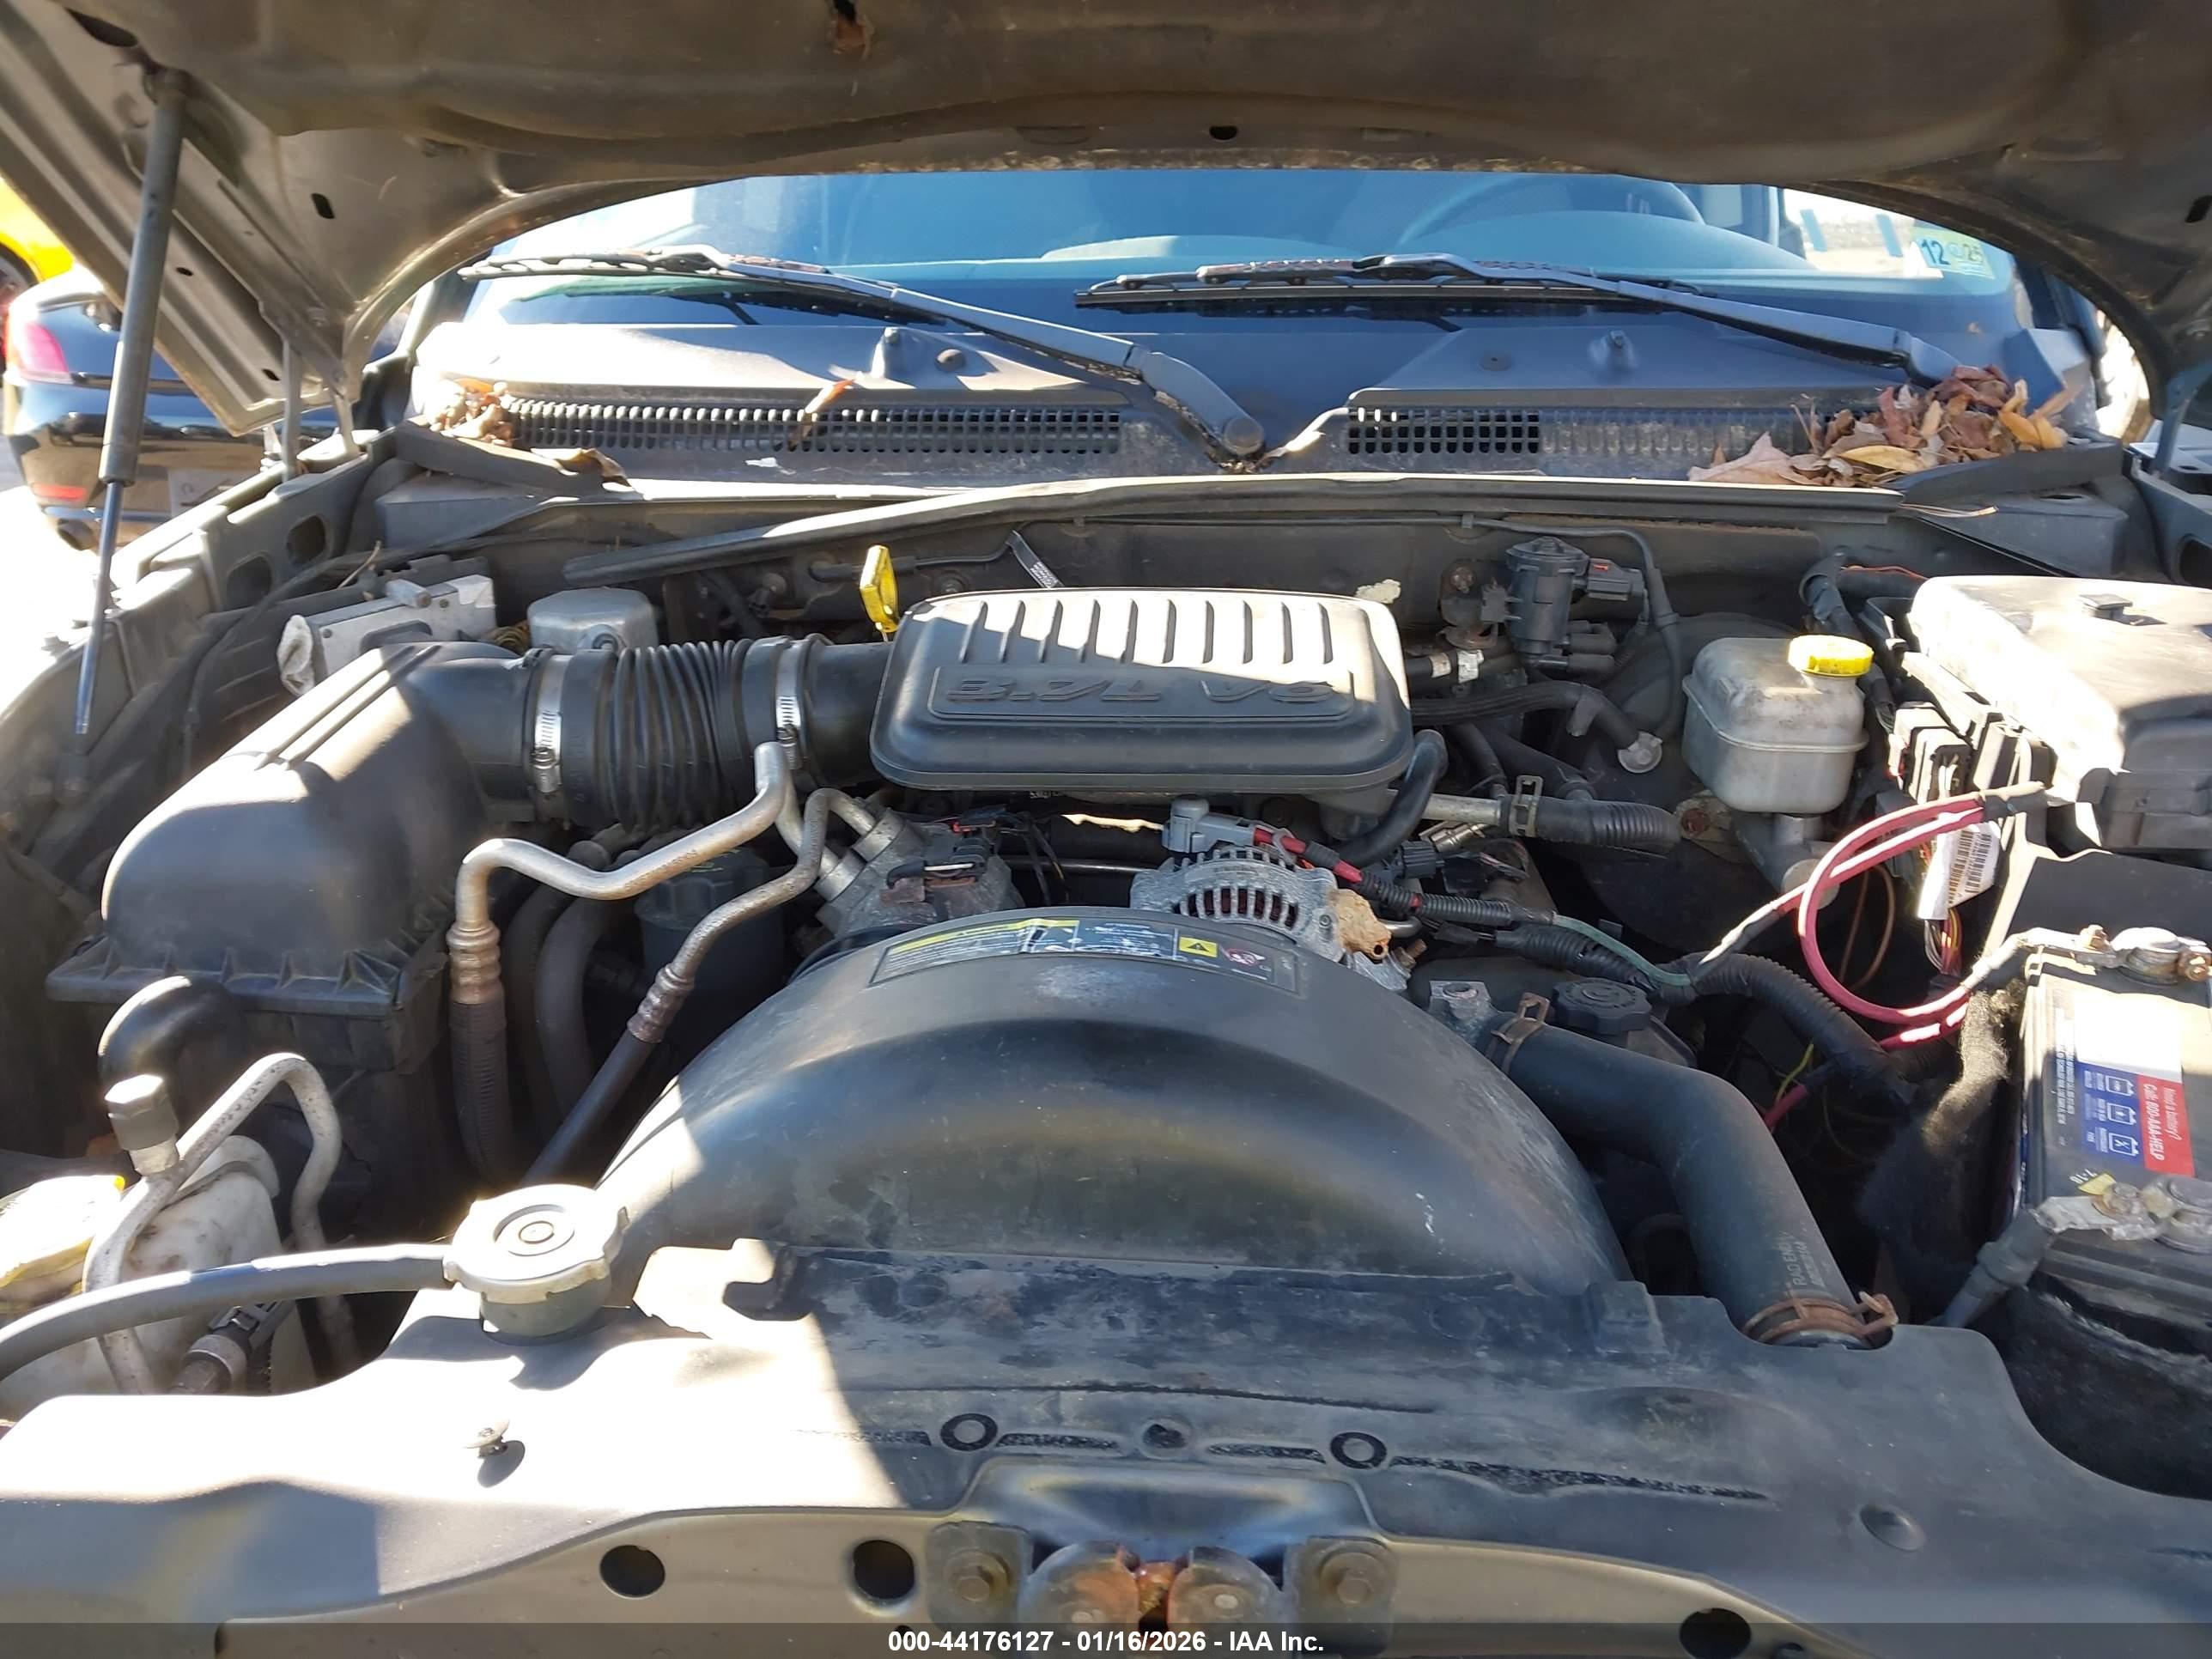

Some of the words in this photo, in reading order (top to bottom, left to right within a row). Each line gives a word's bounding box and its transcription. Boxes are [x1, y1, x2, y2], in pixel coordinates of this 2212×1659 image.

[1922, 239, 1951, 265] 12
[945, 678, 1162, 703] 3.7L
[1200, 678, 1334, 704] V6
